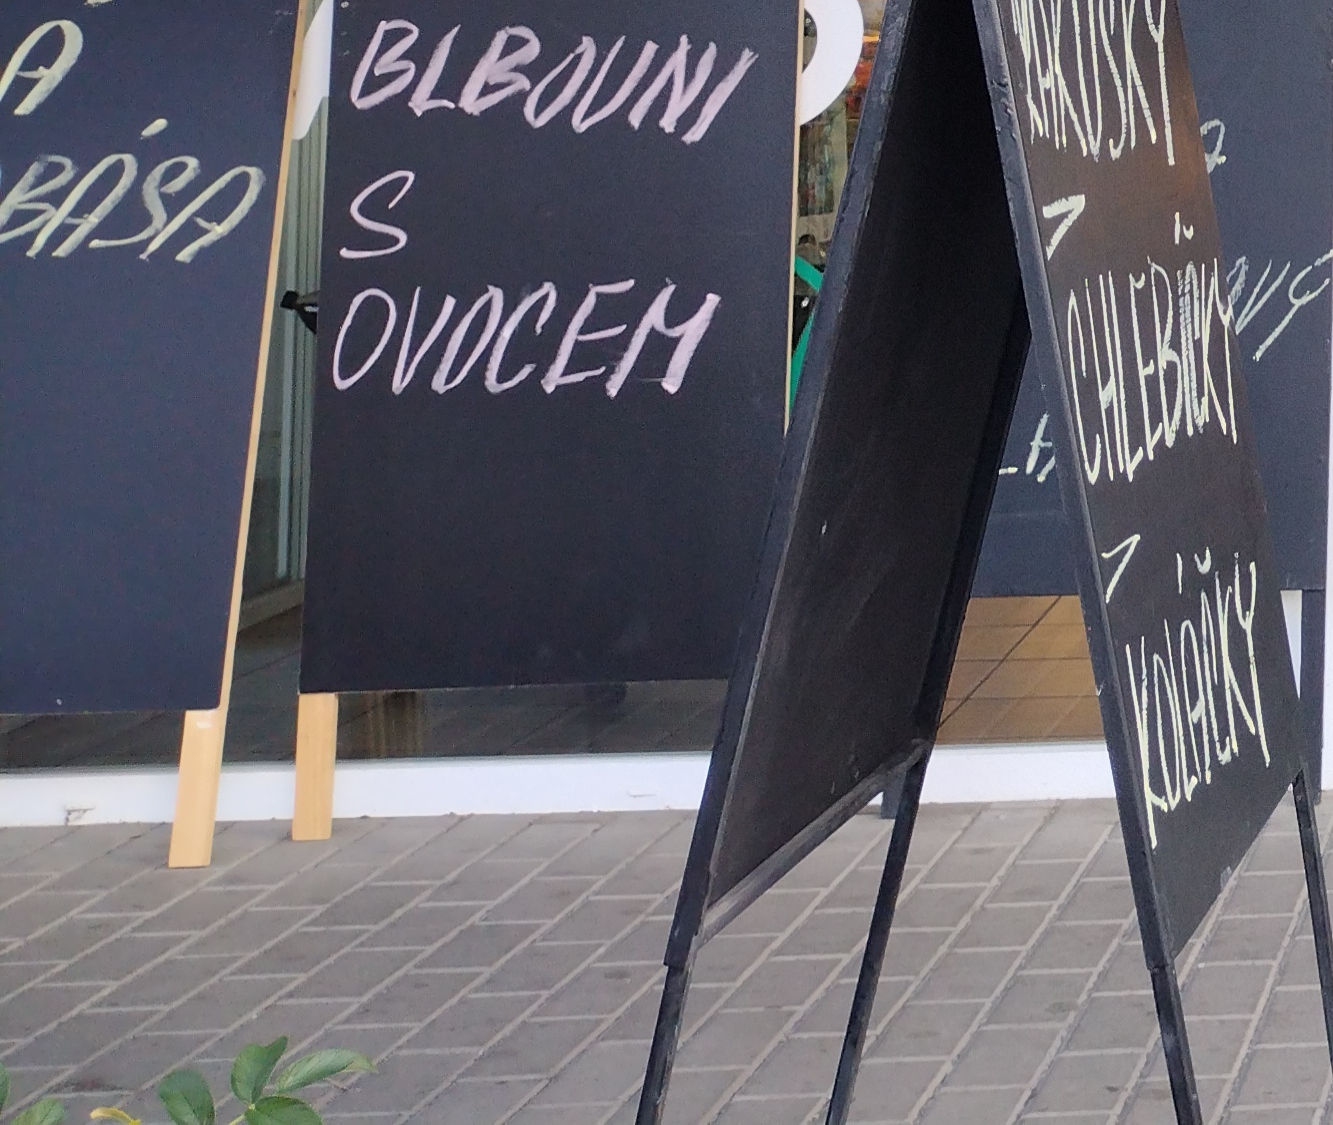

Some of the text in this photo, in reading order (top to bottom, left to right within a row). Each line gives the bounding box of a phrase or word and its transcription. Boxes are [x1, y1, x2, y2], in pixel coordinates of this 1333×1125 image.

[350, 19, 759, 145] BLBOUNI
[339, 170, 416, 259] S
[332, 278, 722, 398] OVOCEM
